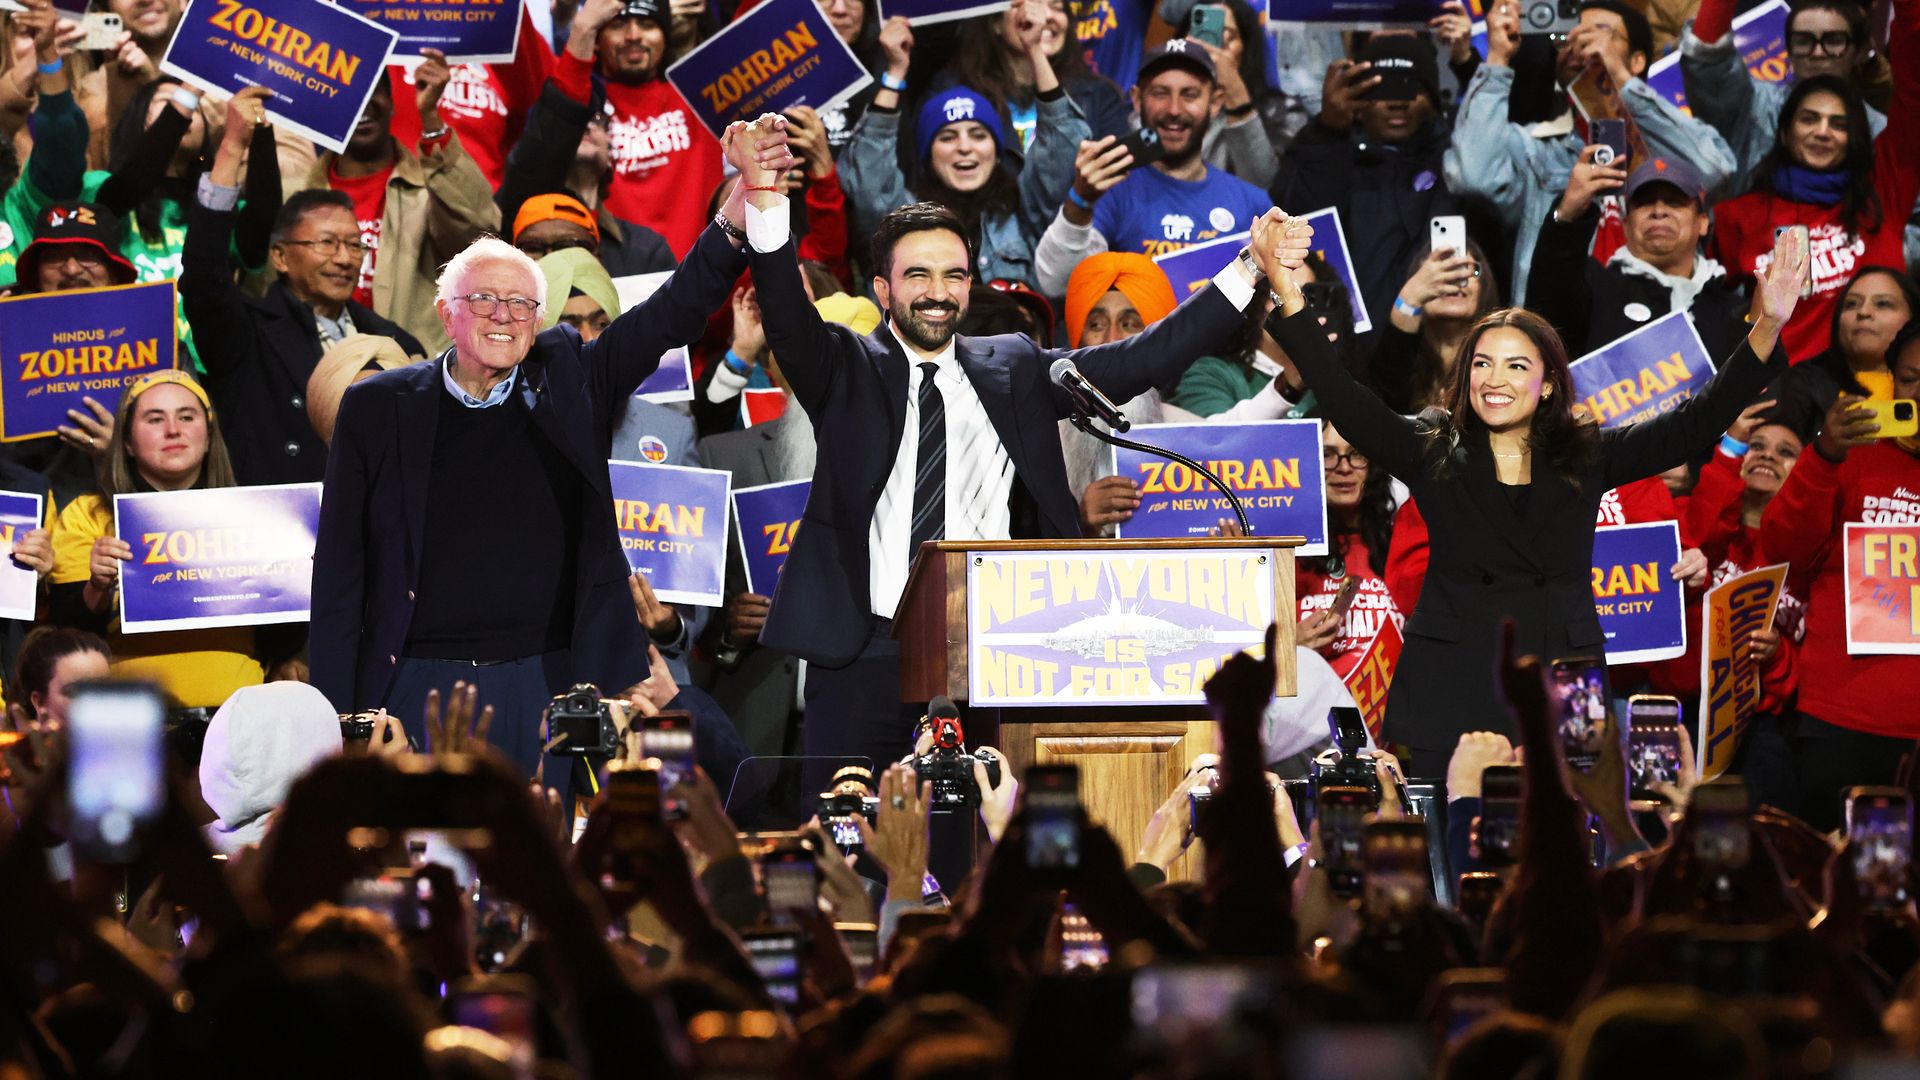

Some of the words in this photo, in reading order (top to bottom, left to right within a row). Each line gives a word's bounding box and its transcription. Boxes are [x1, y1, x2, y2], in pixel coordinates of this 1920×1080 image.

[384, 10, 419, 20] NEW
[424, 10, 461, 22] YORK
[465, 11, 496, 22] CITY
[208, 0, 361, 86] ZOHRAN
[229, 42, 264, 65] NEW
[267, 57, 304, 84] YORK
[305, 77, 339, 98] CITY
[701, 21, 818, 115] ZOHRAN
[793, 54, 820, 79] CITY
[52, 328, 105, 344] HINDUS
[18, 338, 158, 382] ZOHRAN
[46, 381, 80, 394] NEW
[83, 377, 121, 391] YORK
[1584, 351, 1693, 425] HRAN
[1139, 457, 1302, 496] ZOHRAN
[1172, 498, 1209, 511] NEW
[1257, 495, 1294, 508] CITY
[658, 540, 695, 555] CITY
[176, 568, 213, 582] NEW
[216, 565, 258, 579] YORK
[979, 559, 1102, 633] NEW
[1108, 559, 1265, 632] YORK
[1618, 600, 1653, 615] CITY
[1104, 639, 1146, 662] IS
[979, 644, 1059, 698] NOT
[1071, 665, 1150, 697] FOR
[1706, 657, 1735, 767] ALL
